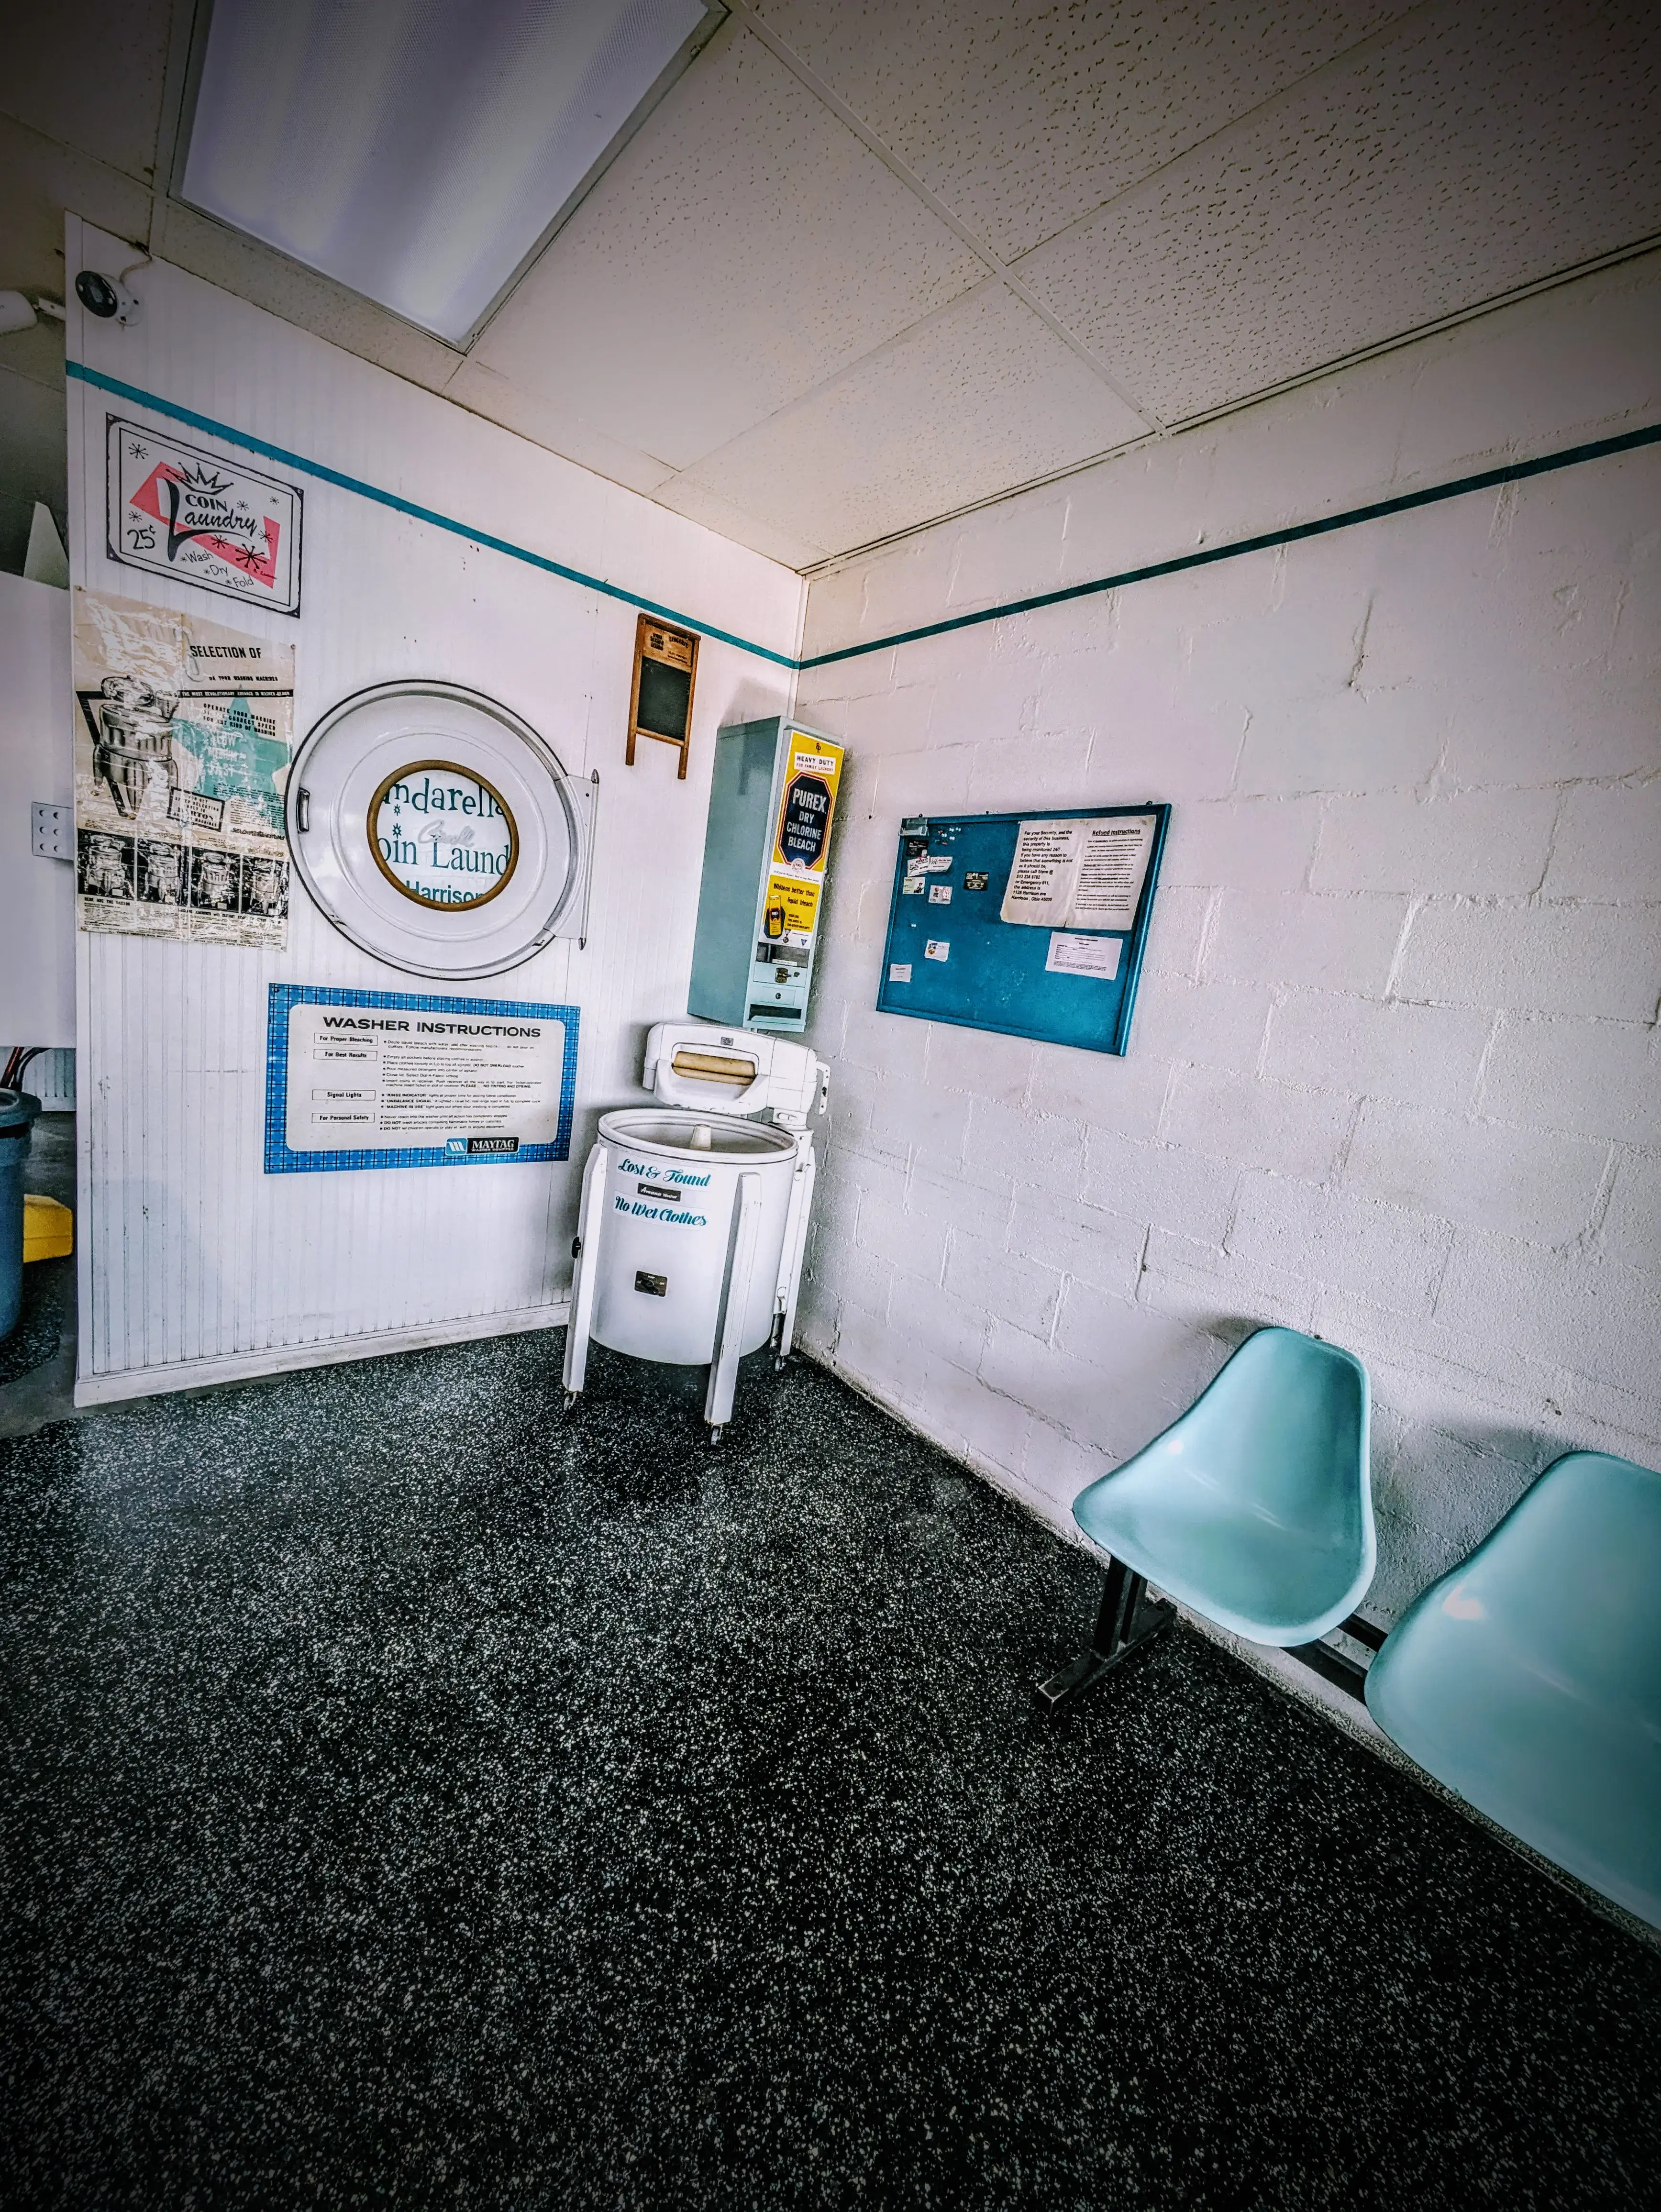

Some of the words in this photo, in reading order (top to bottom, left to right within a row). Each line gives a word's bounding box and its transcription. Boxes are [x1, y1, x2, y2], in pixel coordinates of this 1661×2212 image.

[186, 494, 228, 512] COIN
[162, 476, 257, 562] Laundry
[187, 551, 213, 563] Wash
[210, 565, 228, 576] Dry
[233, 576, 254, 587] Fold
[191, 646, 246, 658] SELECTION
[249, 647, 261, 658] OF
[203, 703, 230, 713] OPERATE
[251, 715, 276, 724] MACHINE
[229, 716, 255, 726] CORRECT
[257, 722, 276, 730] SPEED
[254, 728, 276, 737] WASHING
[793, 788, 826, 813] PUREX
[799, 810, 814, 823] DRY
[787, 821, 822, 840] CHLORINE
[788, 836, 816, 852] BLEACH
[774, 883, 790, 892] Whitens
[791, 886, 804, 895] better
[323, 1017, 410, 1031] WASHER
[417, 1022, 541, 1037] INSTRUCTIONS
[472, 1140, 514, 1149] MAYTAG
[618, 1159, 645, 1175] Lost
[646, 1166, 661, 1179] &
[663, 1170, 711, 1186] Found
[641, 1187, 662, 1196] Amana
[615, 1196, 630, 1211] No
[631, 1202, 658, 1219] Wet
[660, 1209, 707, 1226] Clothes
